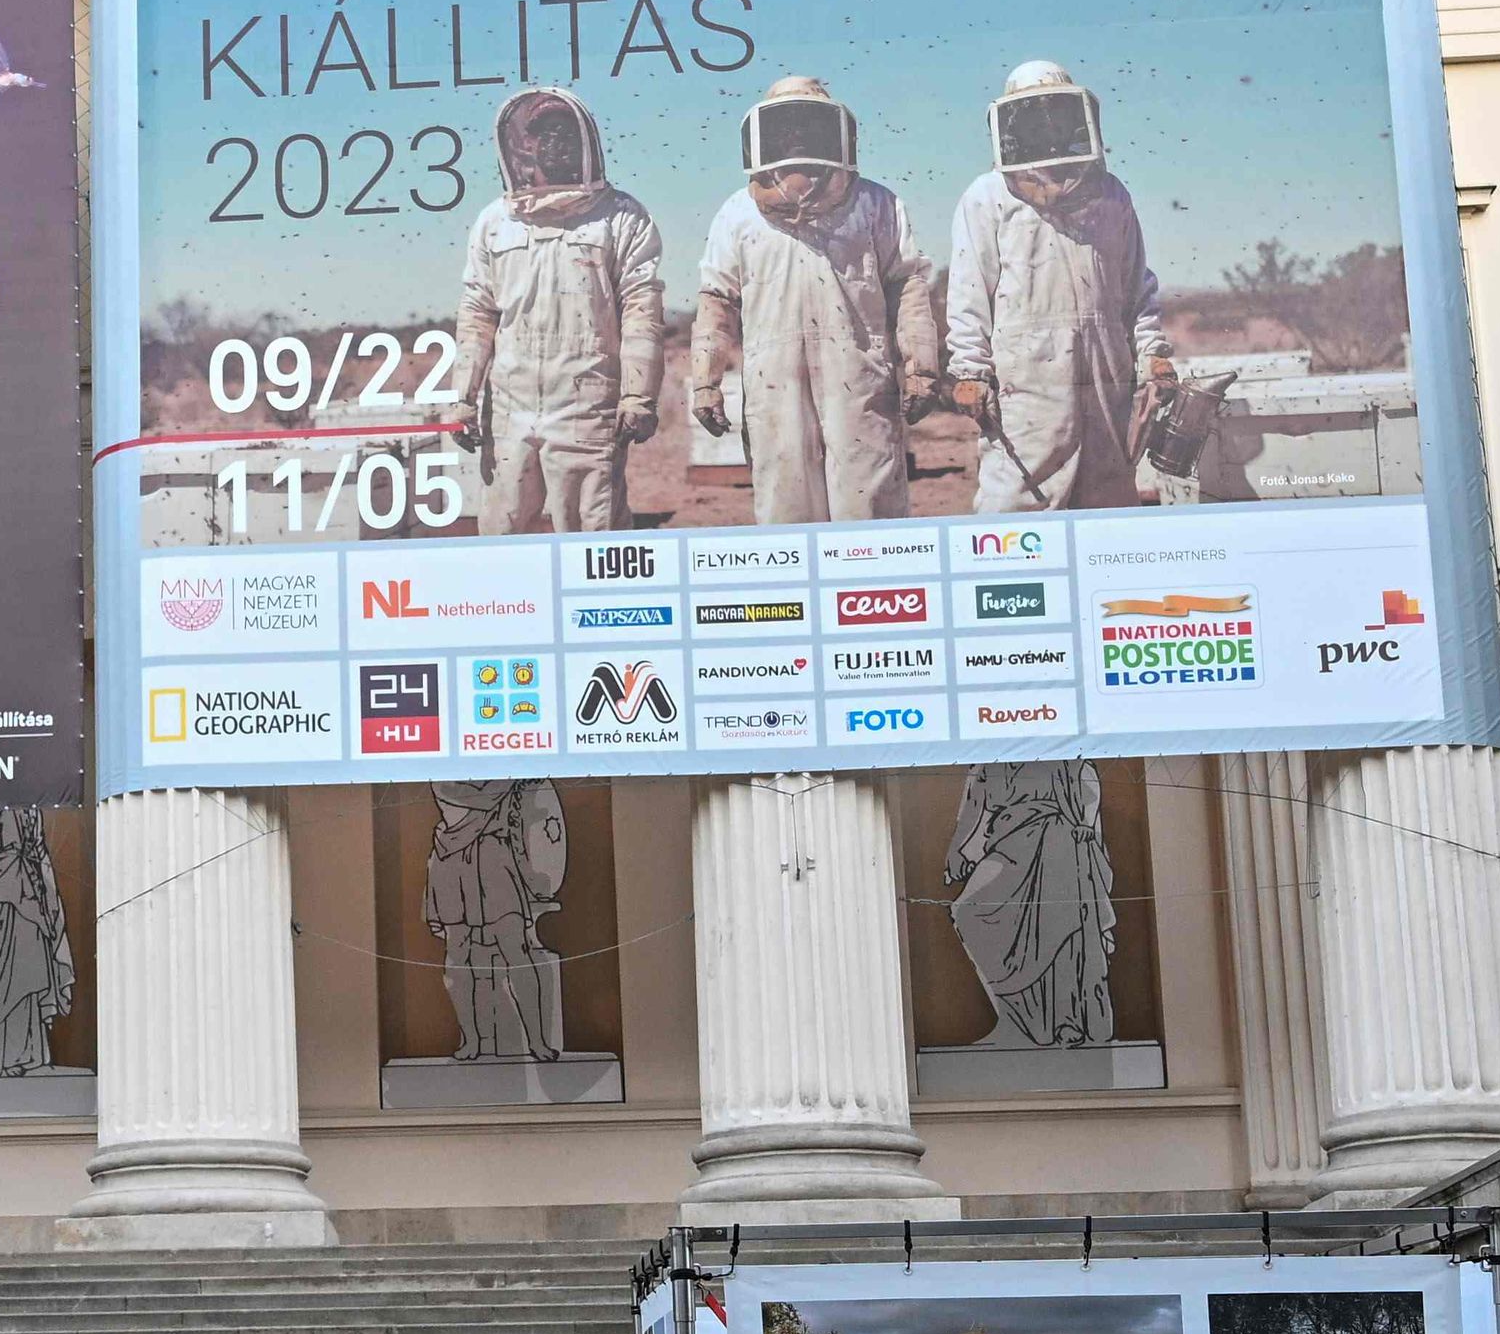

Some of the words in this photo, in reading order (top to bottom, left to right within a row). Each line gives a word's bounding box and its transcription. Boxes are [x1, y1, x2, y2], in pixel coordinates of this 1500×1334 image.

[205, 125, 469, 224] 2023
[207, 329, 460, 415] 09/22
[1260, 475, 1289, 487] Fotó:
[1290, 474, 1325, 485] Jonas
[1327, 472, 1356, 484] Kako
[216, 452, 464, 534] 11/05
[697, 551, 760, 569] FLYING
[766, 549, 801, 566] ADS
[823, 549, 840, 559] WE
[846, 547, 874, 558] LOVE
[881, 544, 935, 556] BUDAPEST
[1088, 551, 1156, 566] STRATEGIC
[1159, 548, 1227, 563] PARTNERS
[160, 578, 224, 600] MNM
[243, 574, 316, 592] MAGYAR
[243, 593, 318, 611] NEMZETI
[362, 578, 430, 620] NL
[436, 599, 536, 618] Netherlands
[243, 610, 318, 631] MÚZEUM
[584, 607, 665, 626] NÉPSZAVA
[1117, 621, 1236, 641] NATIONALE
[834, 648, 933, 671] FUJIFILM
[966, 654, 1003, 668] HAMU
[1008, 649, 1067, 666] GYÉMÁNT
[1103, 638, 1255, 669] POSTCODE
[1317, 639, 1401, 674] pwc
[698, 664, 799, 680] RANDIVONAL
[837, 671, 861, 681] Value
[863, 671, 884, 680] from
[885, 669, 931, 680] Innovation
[1122, 667, 1238, 686] LOTERIJ
[195, 689, 302, 712] NATIONAL
[368, 673, 428, 710] 24
[978, 703, 1058, 724] Reverb
[194, 712, 332, 737] GEOGRAPHIC
[463, 731, 553, 752] REGGELI
[576, 728, 623, 744] METRÓ
[626, 728, 679, 744] REKLÁM
